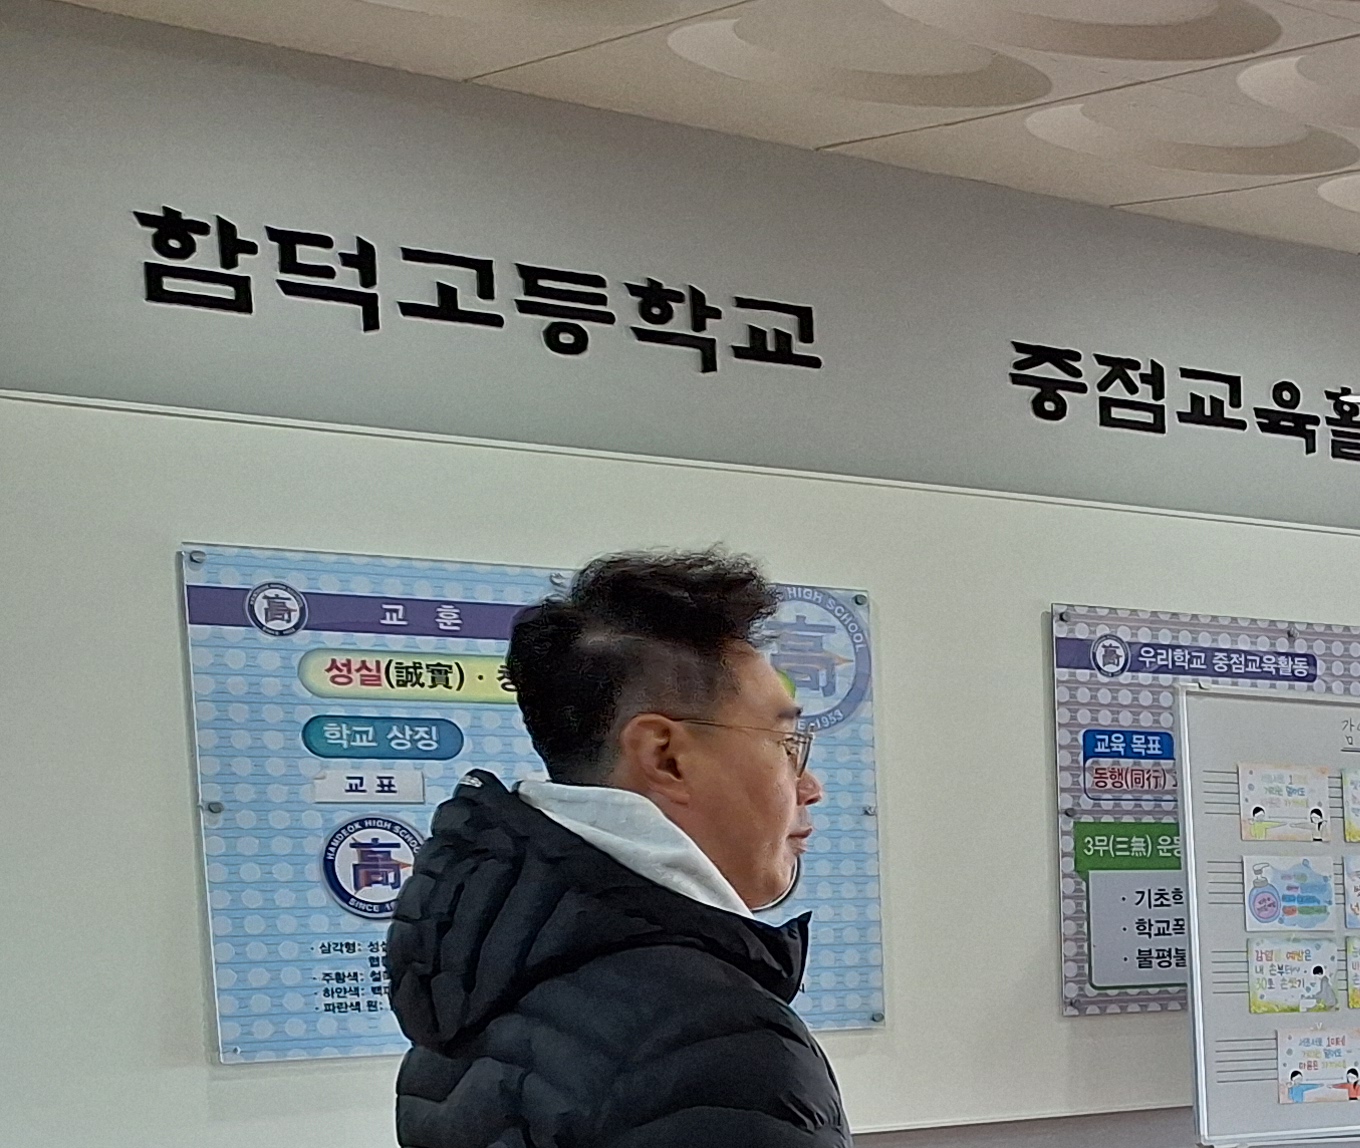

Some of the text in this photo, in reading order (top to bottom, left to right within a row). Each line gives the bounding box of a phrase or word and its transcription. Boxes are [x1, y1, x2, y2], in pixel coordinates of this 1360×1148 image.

[133, 205, 824, 374] 함덕고등학교
[787, 586, 867, 652] HIGH SCHOOL
[324, 657, 465, 692] 성실(誠實)
[1138, 646, 1310, 678] 우리학교 중점교육활동
[323, 723, 439, 751] 학교 상징
[1094, 733, 1163, 755] 교육 목표
[1093, 767, 1168, 790] 동행(同行)
[316, 819, 420, 860] HAMDEOK HIGH SCHOO
